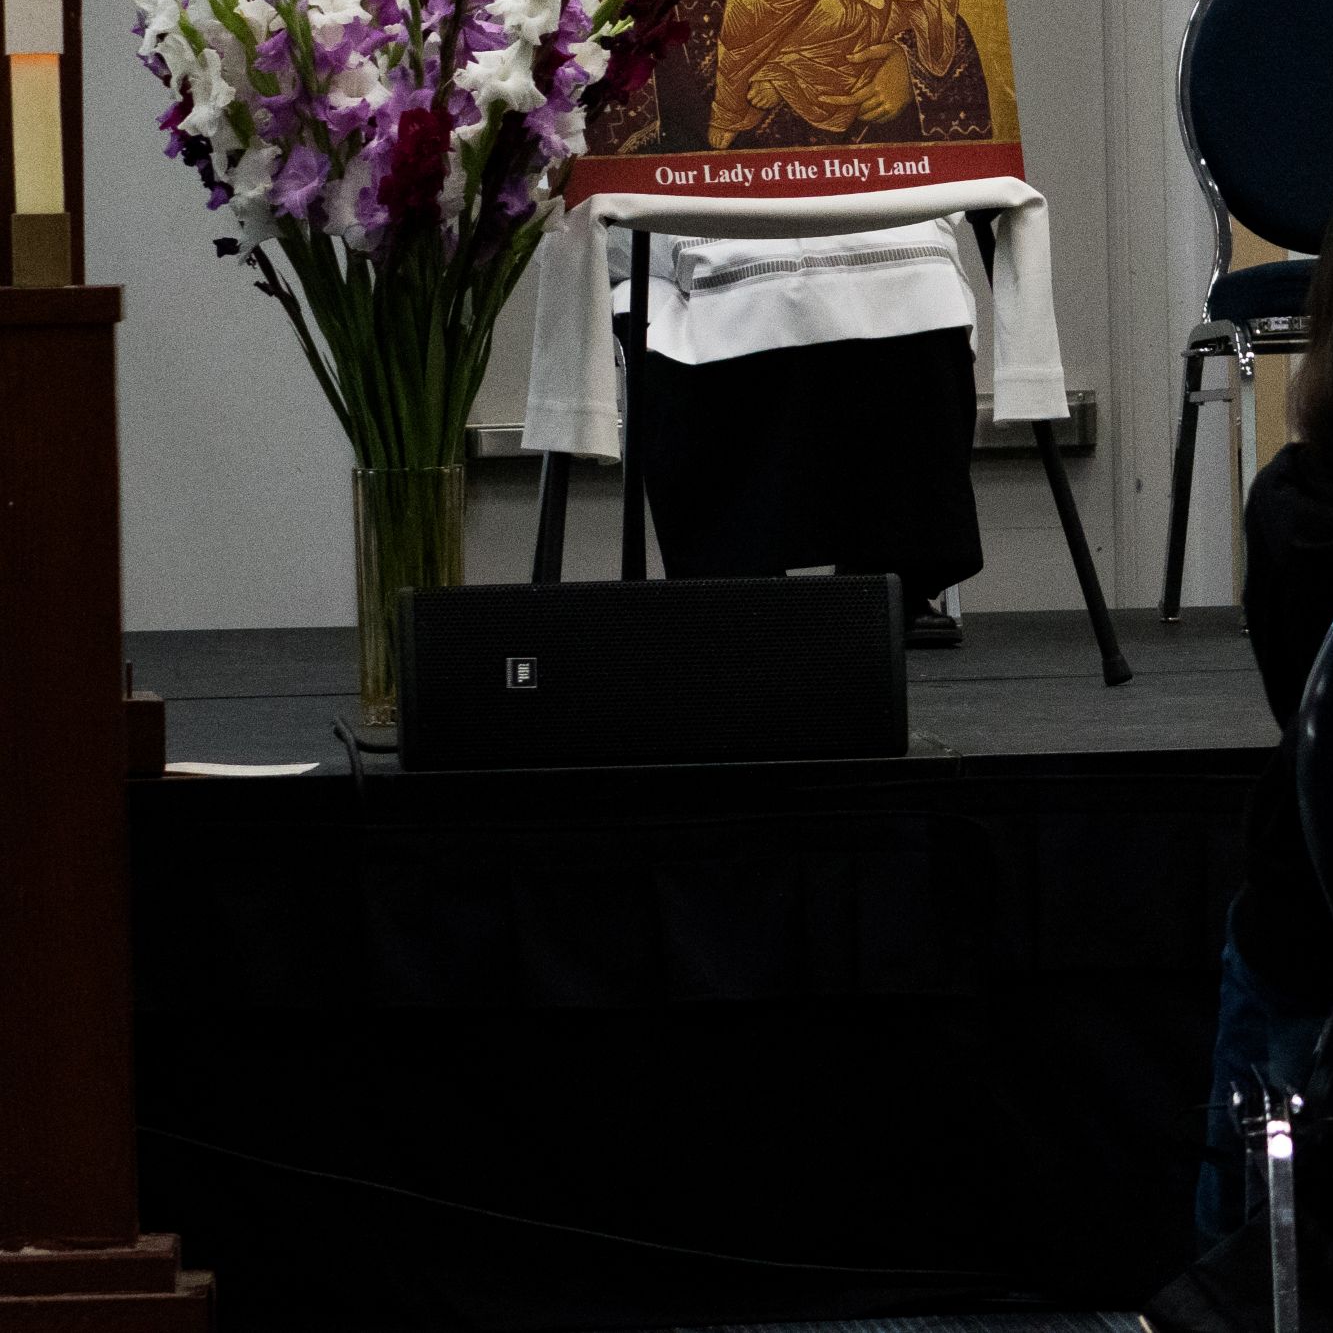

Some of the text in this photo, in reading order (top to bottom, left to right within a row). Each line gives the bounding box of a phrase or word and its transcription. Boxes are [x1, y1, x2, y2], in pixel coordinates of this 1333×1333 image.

[655, 156, 930, 187] Our Lady of the Holy Land
